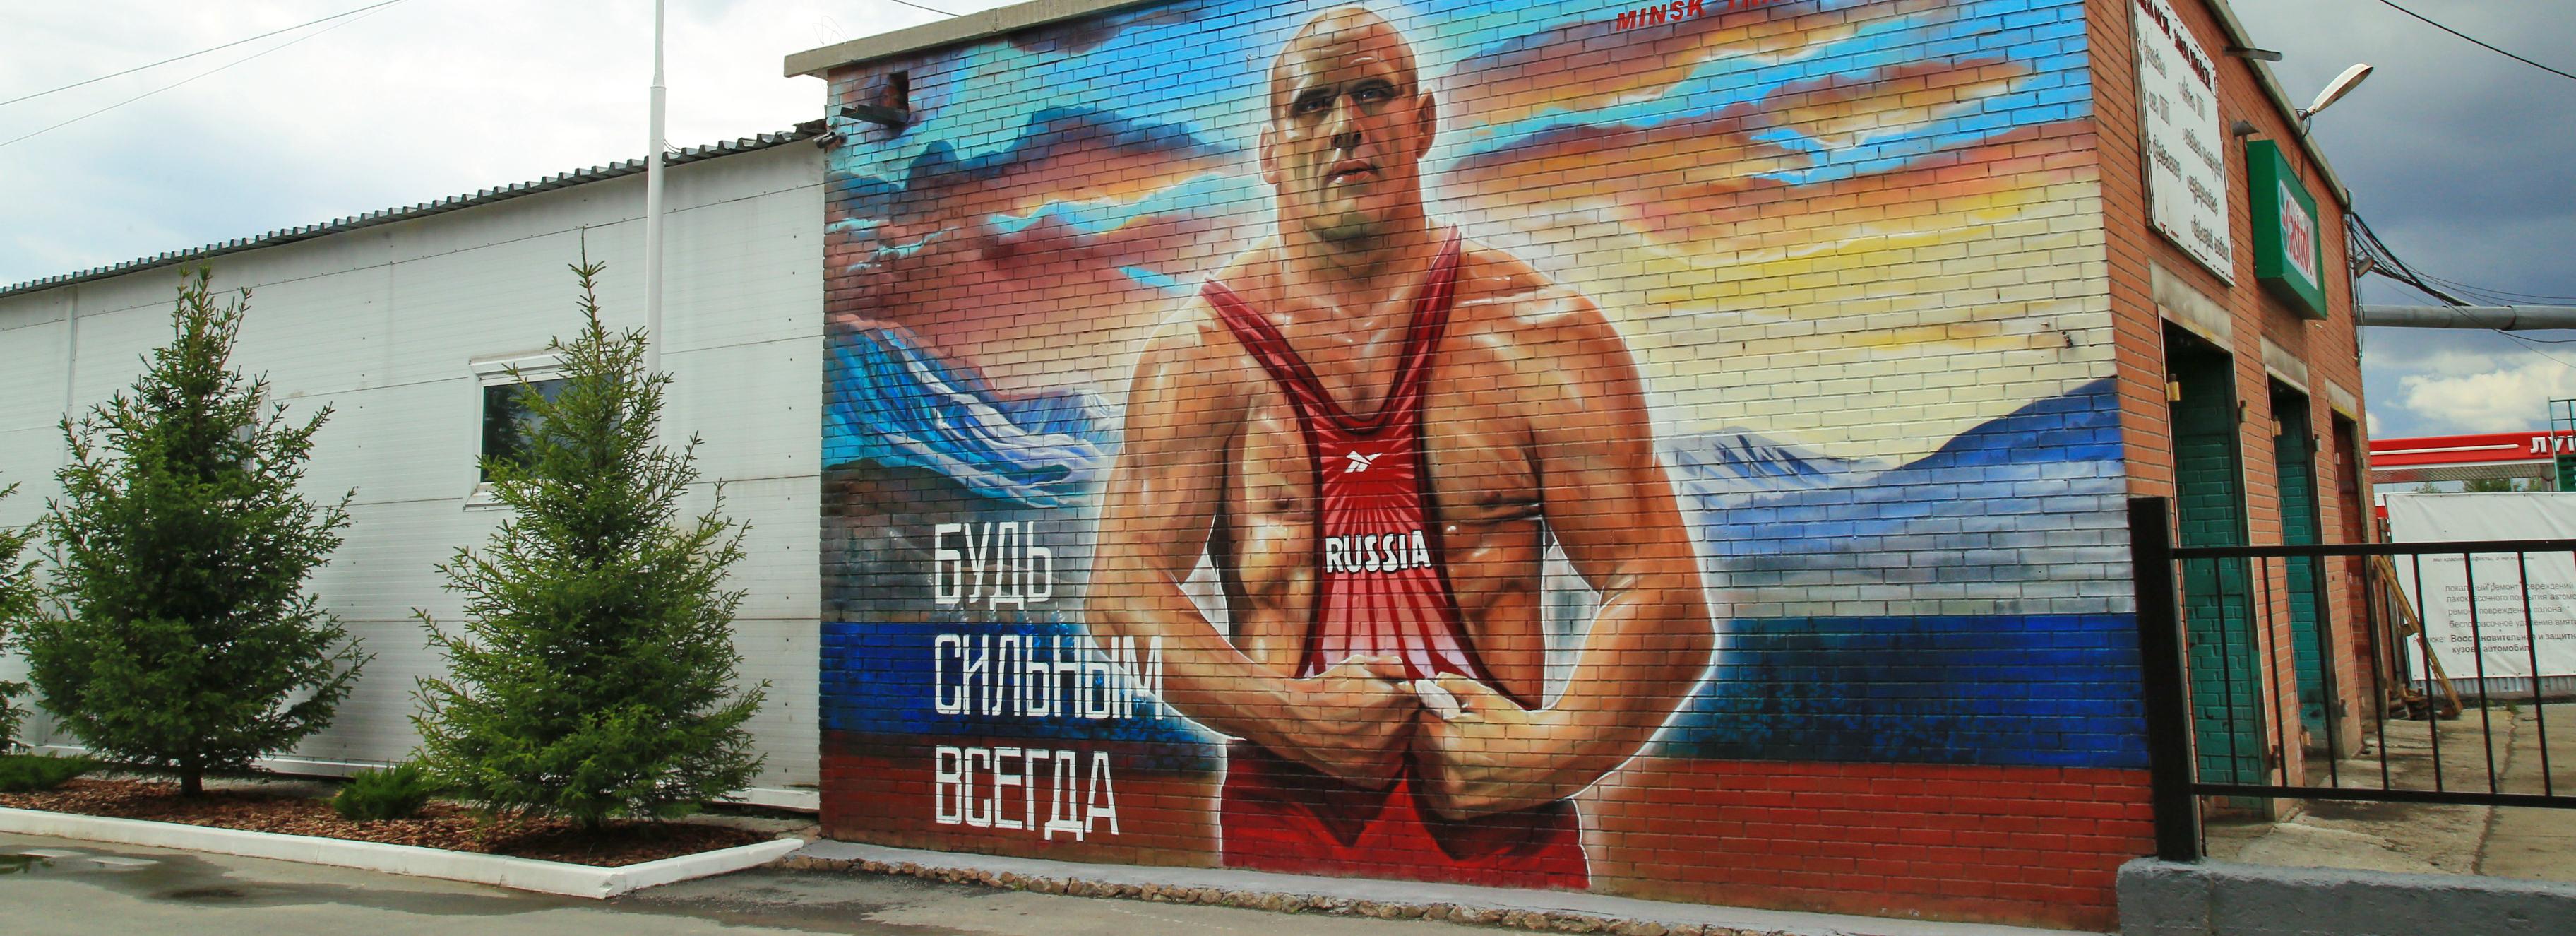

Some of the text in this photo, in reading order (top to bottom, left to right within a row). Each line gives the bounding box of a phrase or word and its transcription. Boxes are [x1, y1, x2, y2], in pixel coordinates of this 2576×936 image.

[1616, 0, 1706, 31] MINSK
[2284, 199, 2313, 276] Castrol
[934, 521, 1053, 610] БУДЬ
[1325, 530, 1432, 574] RUSSIA
[934, 634, 1164, 721] СИЛЬНЫМ
[2483, 644, 2529, 652] автомобил
[935, 745, 1119, 842] ВСЕГДА
